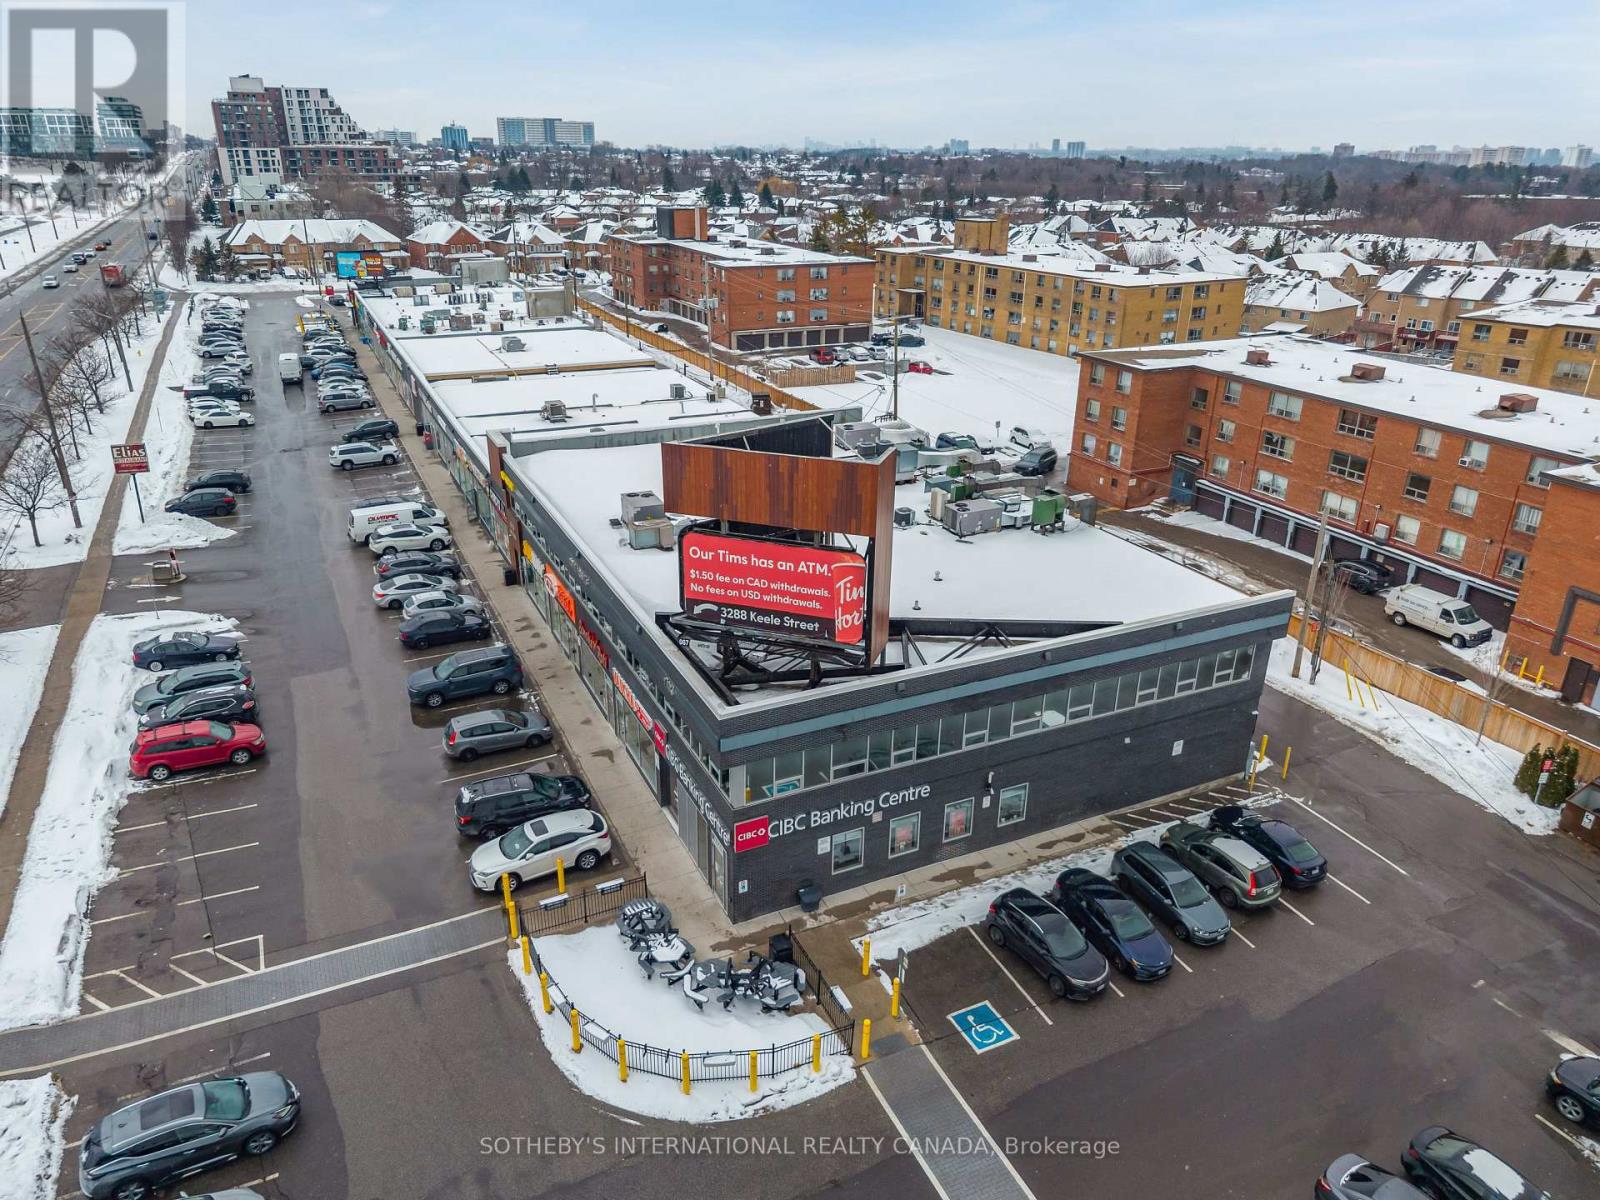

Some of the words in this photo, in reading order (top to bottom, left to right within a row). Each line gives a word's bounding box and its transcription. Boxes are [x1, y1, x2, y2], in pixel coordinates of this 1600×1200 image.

[689, 546, 715, 560] Our
[718, 549, 748, 565] Tims
[751, 554, 774, 568] has
[777, 561, 795, 571] an
[797, 561, 832, 576] ATM.
[689, 569, 714, 580] $1.50
[716, 573, 731, 583] fee
[746, 577, 768, 588] CAD
[770, 581, 832, 597] withdrawals.
[690, 583, 704, 592] No
[705, 584, 725, 595] fees
[727, 589, 739, 597] on
[741, 590, 760, 600] USD
[762, 594, 823, 609] withdrawals.
[720, 607, 747, 619] 3288
[750, 611, 781, 625] Keele
[783, 616, 820, 631] Street
[704, 802, 731, 847] Centre
[768, 814, 806, 838] CIBC
[810, 800, 875, 828] Banking
[878, 784, 931, 808] Centre
[737, 831, 758, 842] CIBC
